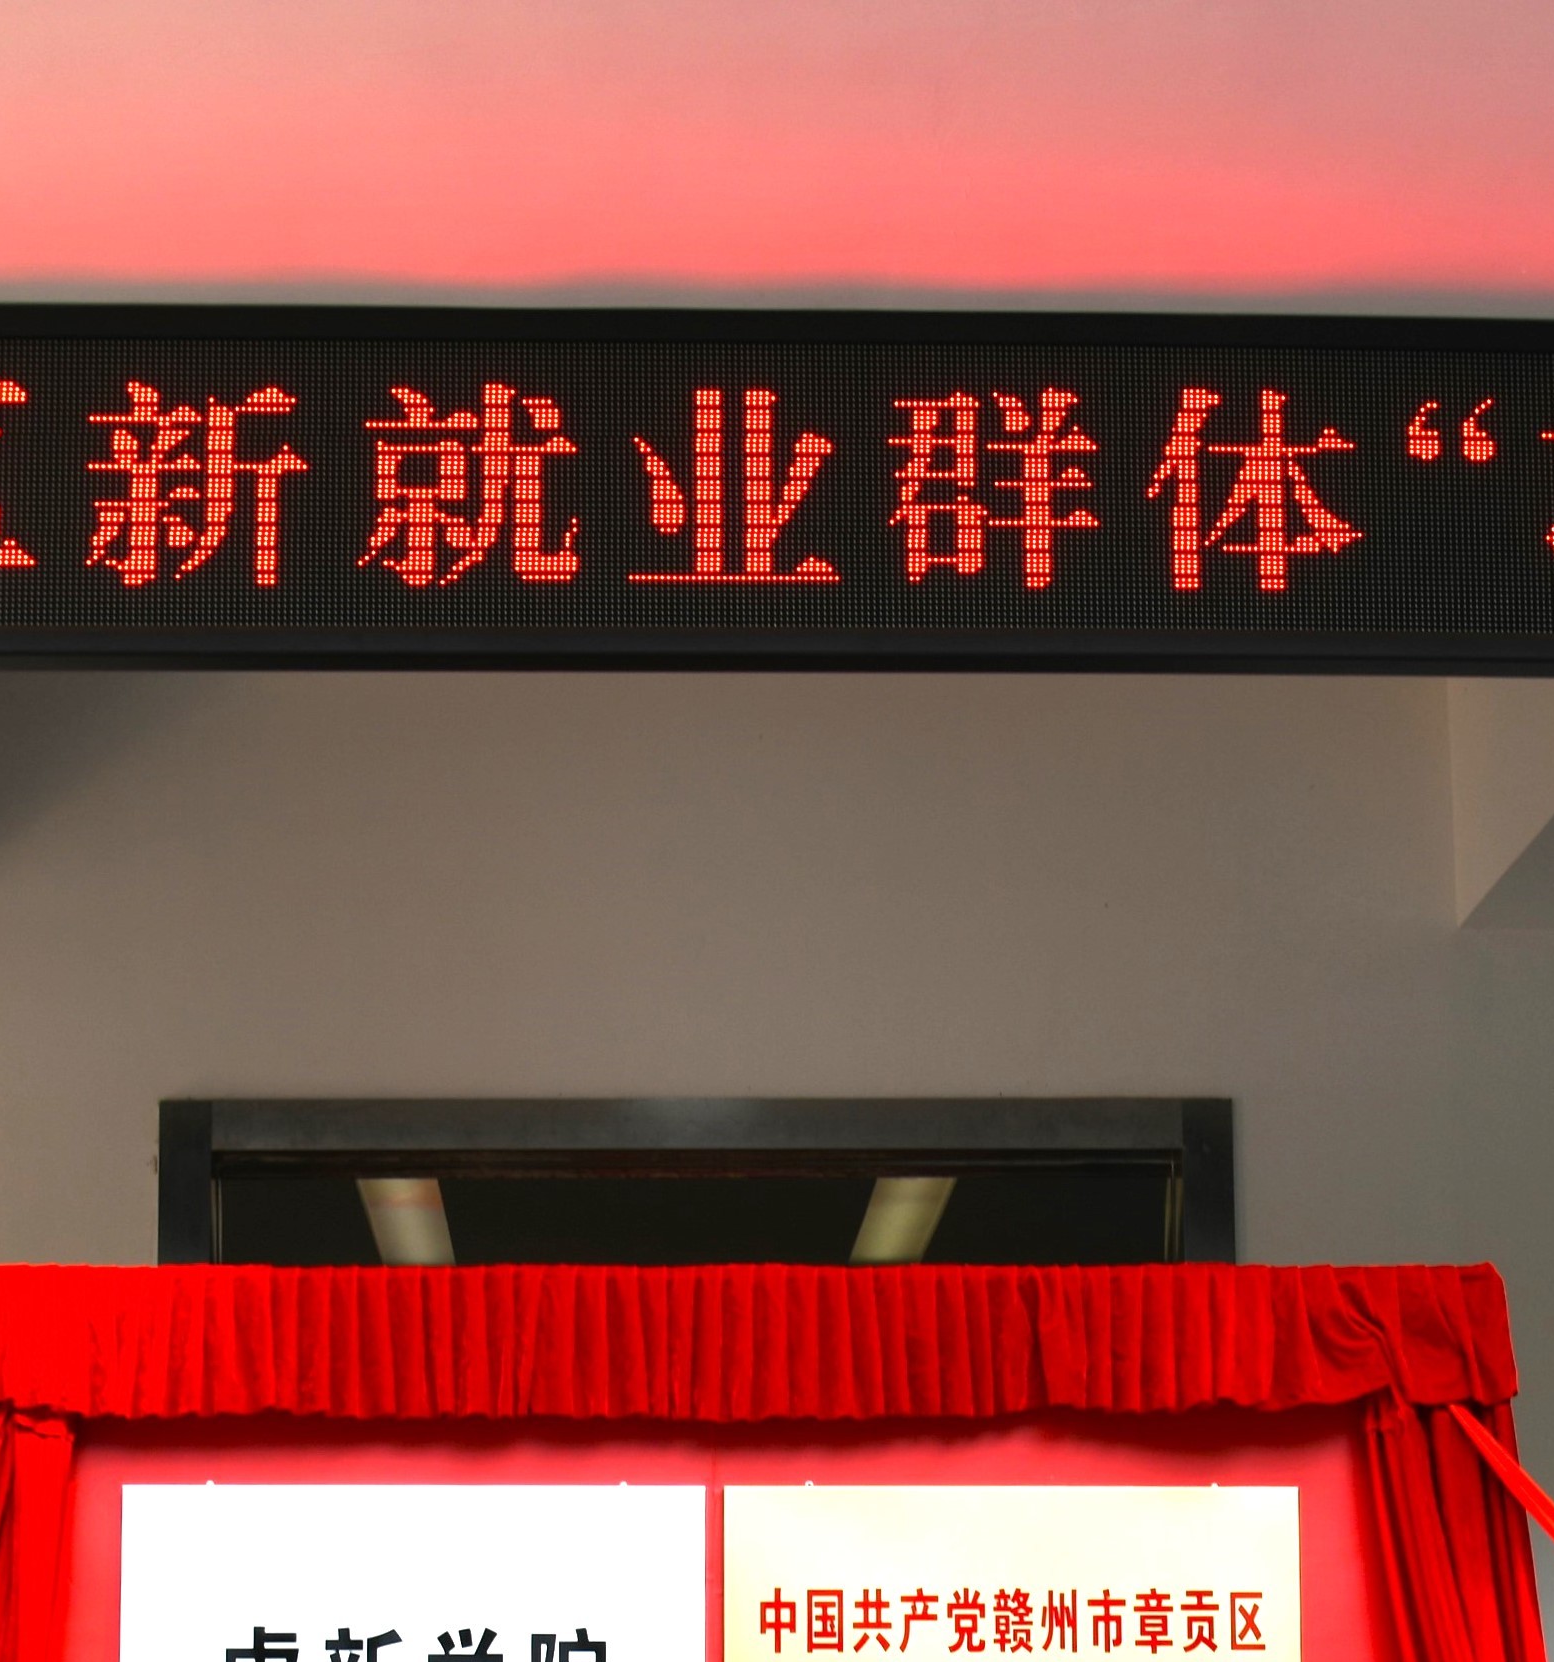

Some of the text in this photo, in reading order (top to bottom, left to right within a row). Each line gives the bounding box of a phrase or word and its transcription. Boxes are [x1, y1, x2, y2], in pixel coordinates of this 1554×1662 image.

[759, 1586, 1266, 1654] 中国共产党赣州市章贡区
